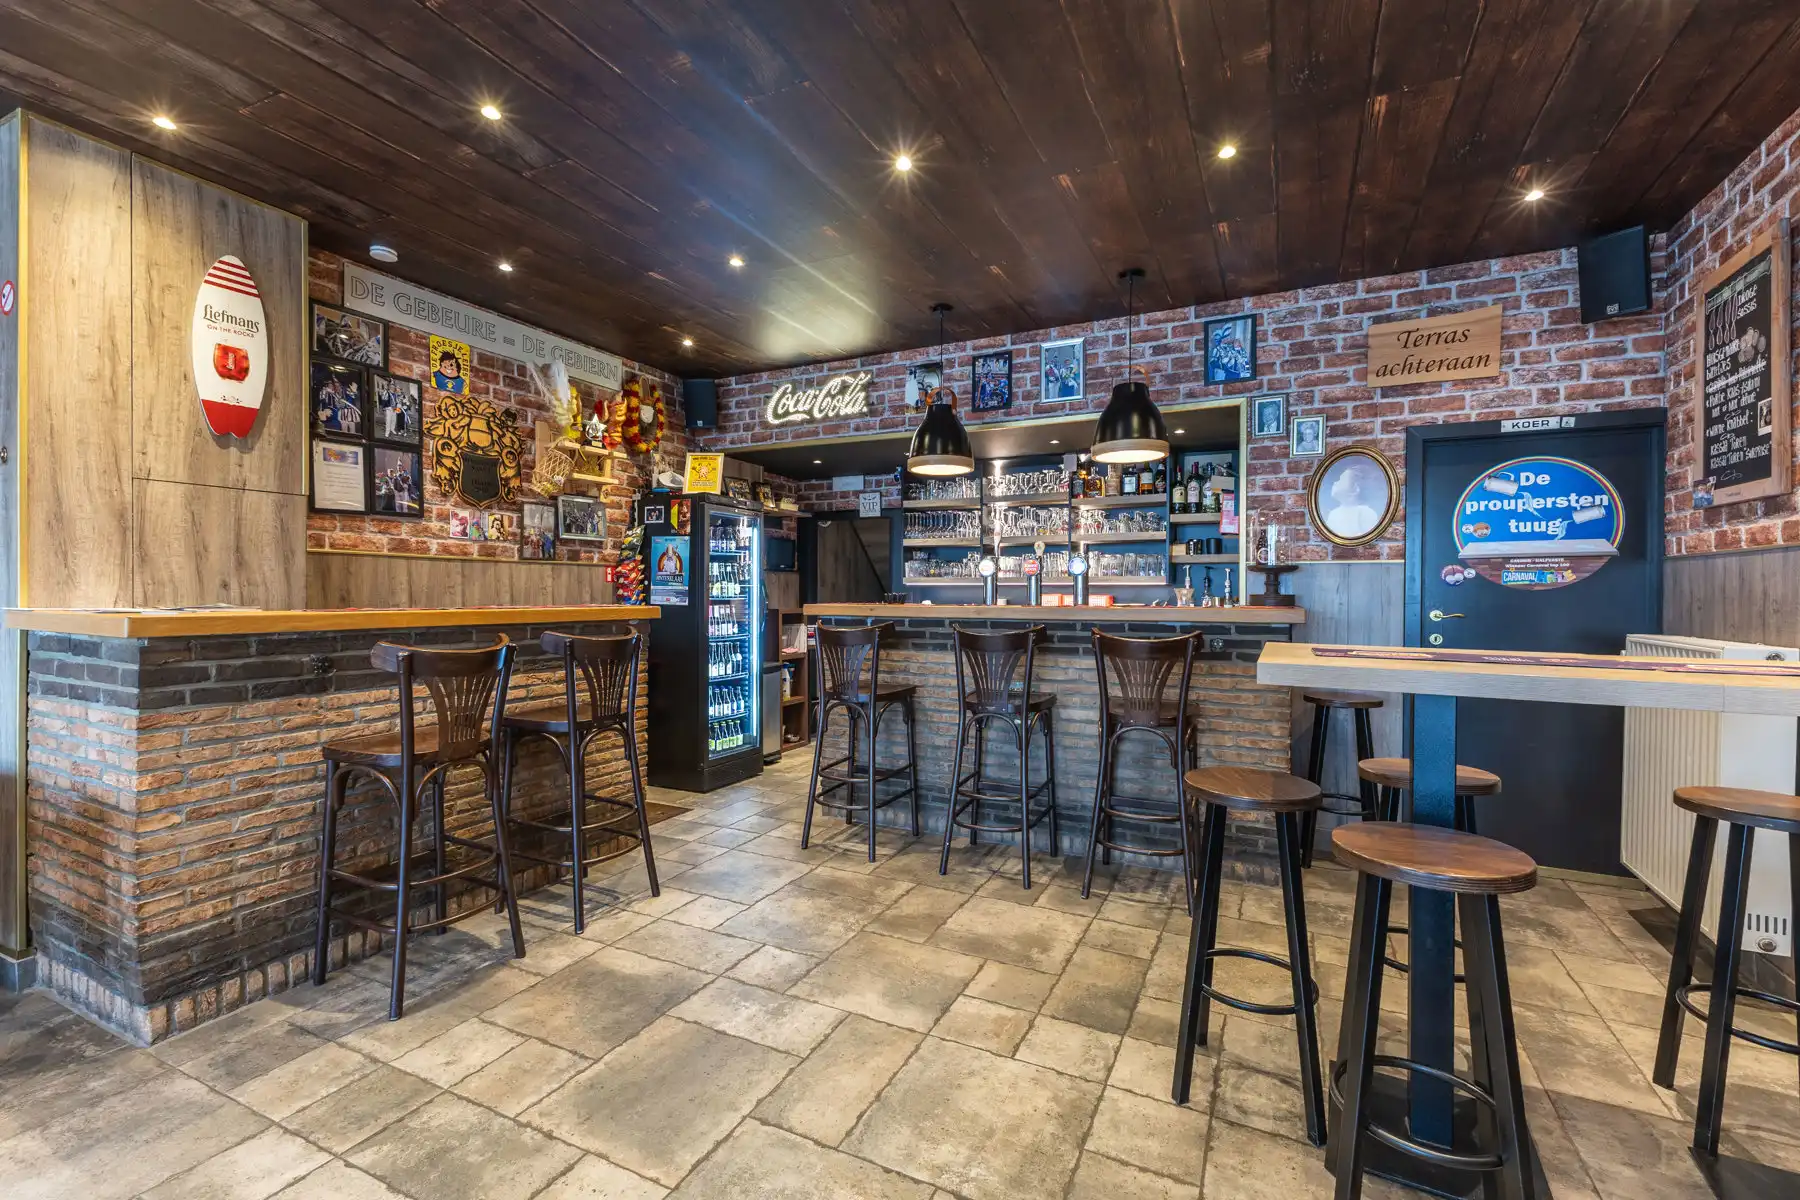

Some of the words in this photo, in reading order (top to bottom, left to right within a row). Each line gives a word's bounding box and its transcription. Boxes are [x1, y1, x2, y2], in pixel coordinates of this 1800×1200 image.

[203, 304, 260, 333] Liefmans
[233, 329, 255, 338] ROCKS
[351, 276, 385, 306] DE
[393, 292, 496, 342] GEBEURE
[522, 334, 546, 359] DE
[550, 345, 619, 381] GEBIERN
[1397, 327, 1471, 349] Terras
[1375, 353, 1491, 378] achteraan
[1512, 420, 1550, 429] KOER
[1519, 472, 1551, 486] De
[862, 502, 878, 510] VIP
[1465, 493, 1609, 515] proupersten
[1508, 518, 1563, 535] tuug
[1503, 571, 1536, 582] CARNAVAL
